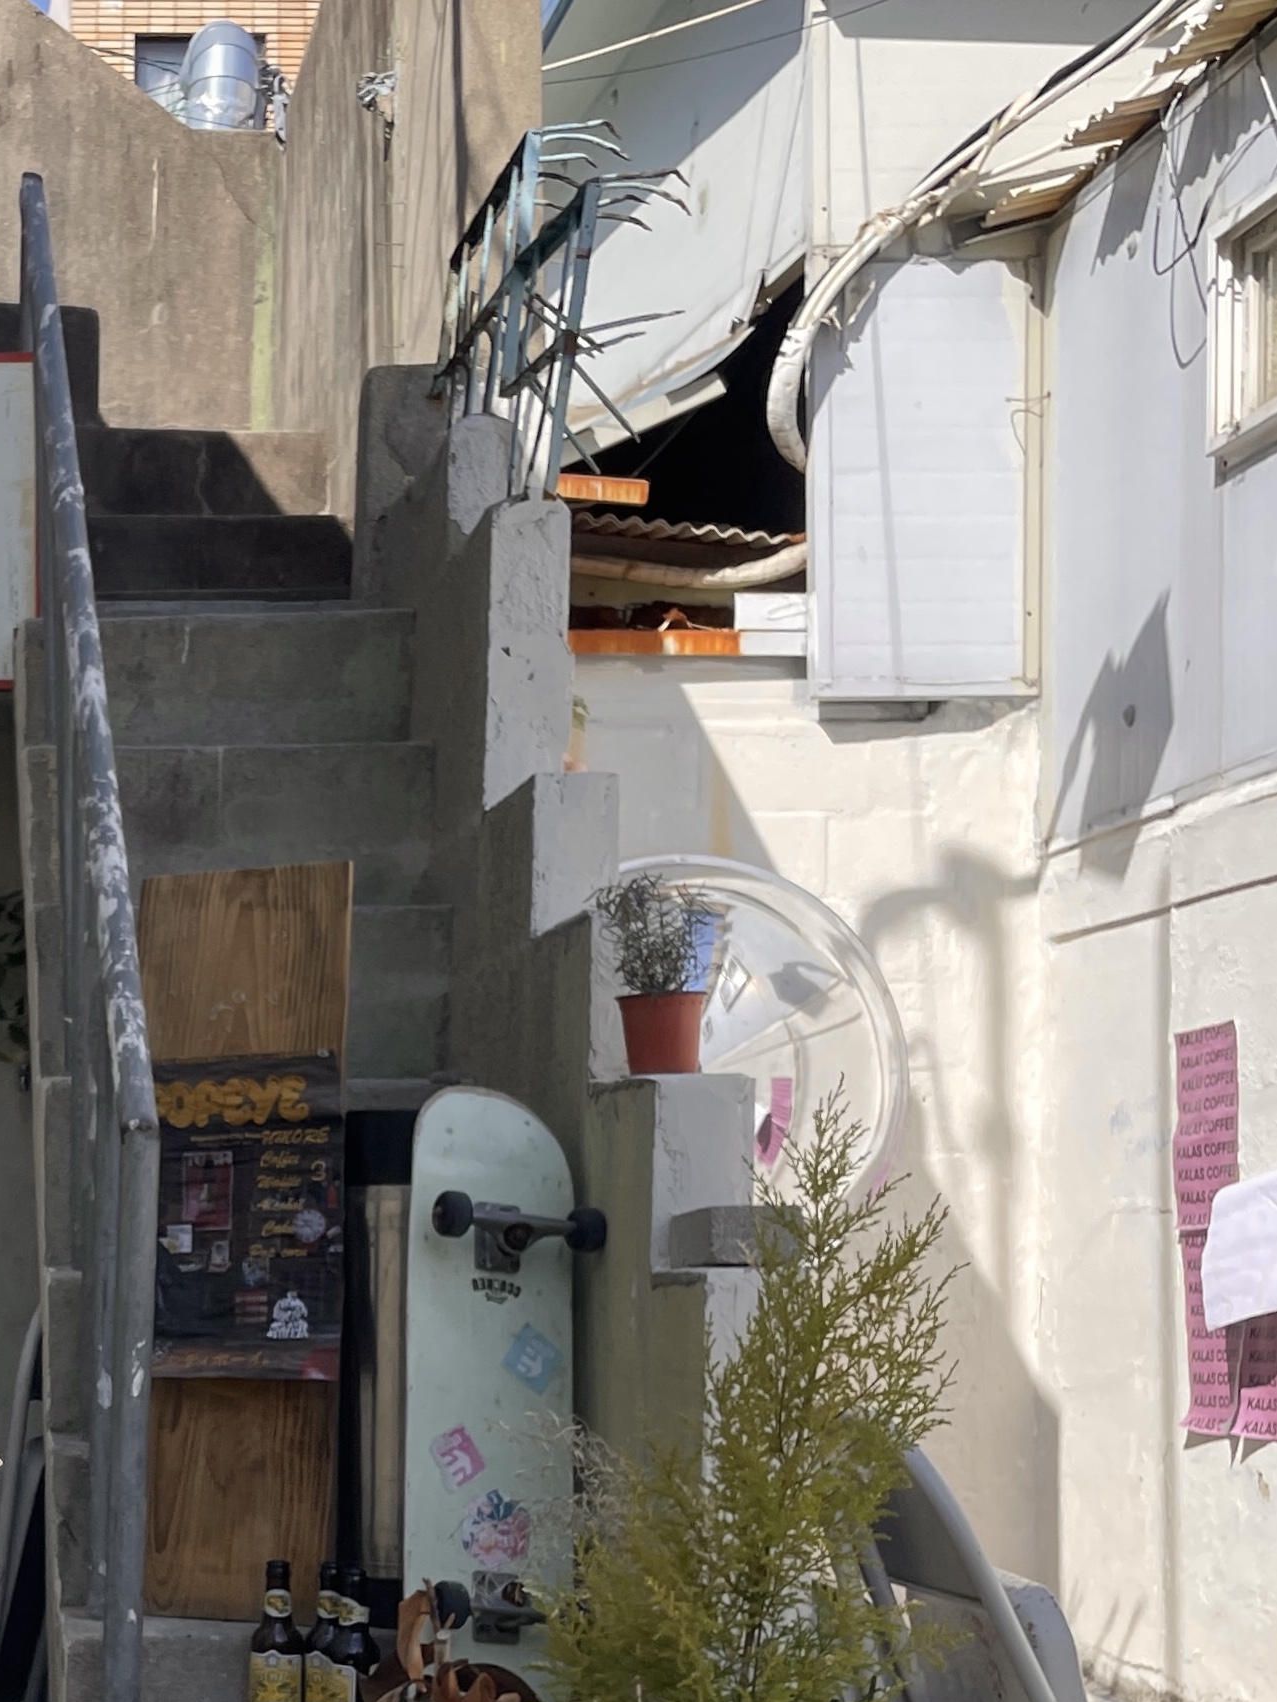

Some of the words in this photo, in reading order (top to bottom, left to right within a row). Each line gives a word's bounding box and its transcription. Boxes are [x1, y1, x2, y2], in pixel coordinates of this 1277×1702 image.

[1204, 1070, 1235, 1087] COFFEE
[1203, 1093, 1236, 1111] COFFEE
[1176, 1144, 1202, 1159] KALAS
[1203, 1140, 1236, 1157] COFFEE
[1178, 1167, 1205, 1182] KALAS
[1180, 1190, 1206, 1205] KALAS
[1193, 1395, 1217, 1408] KALAS
